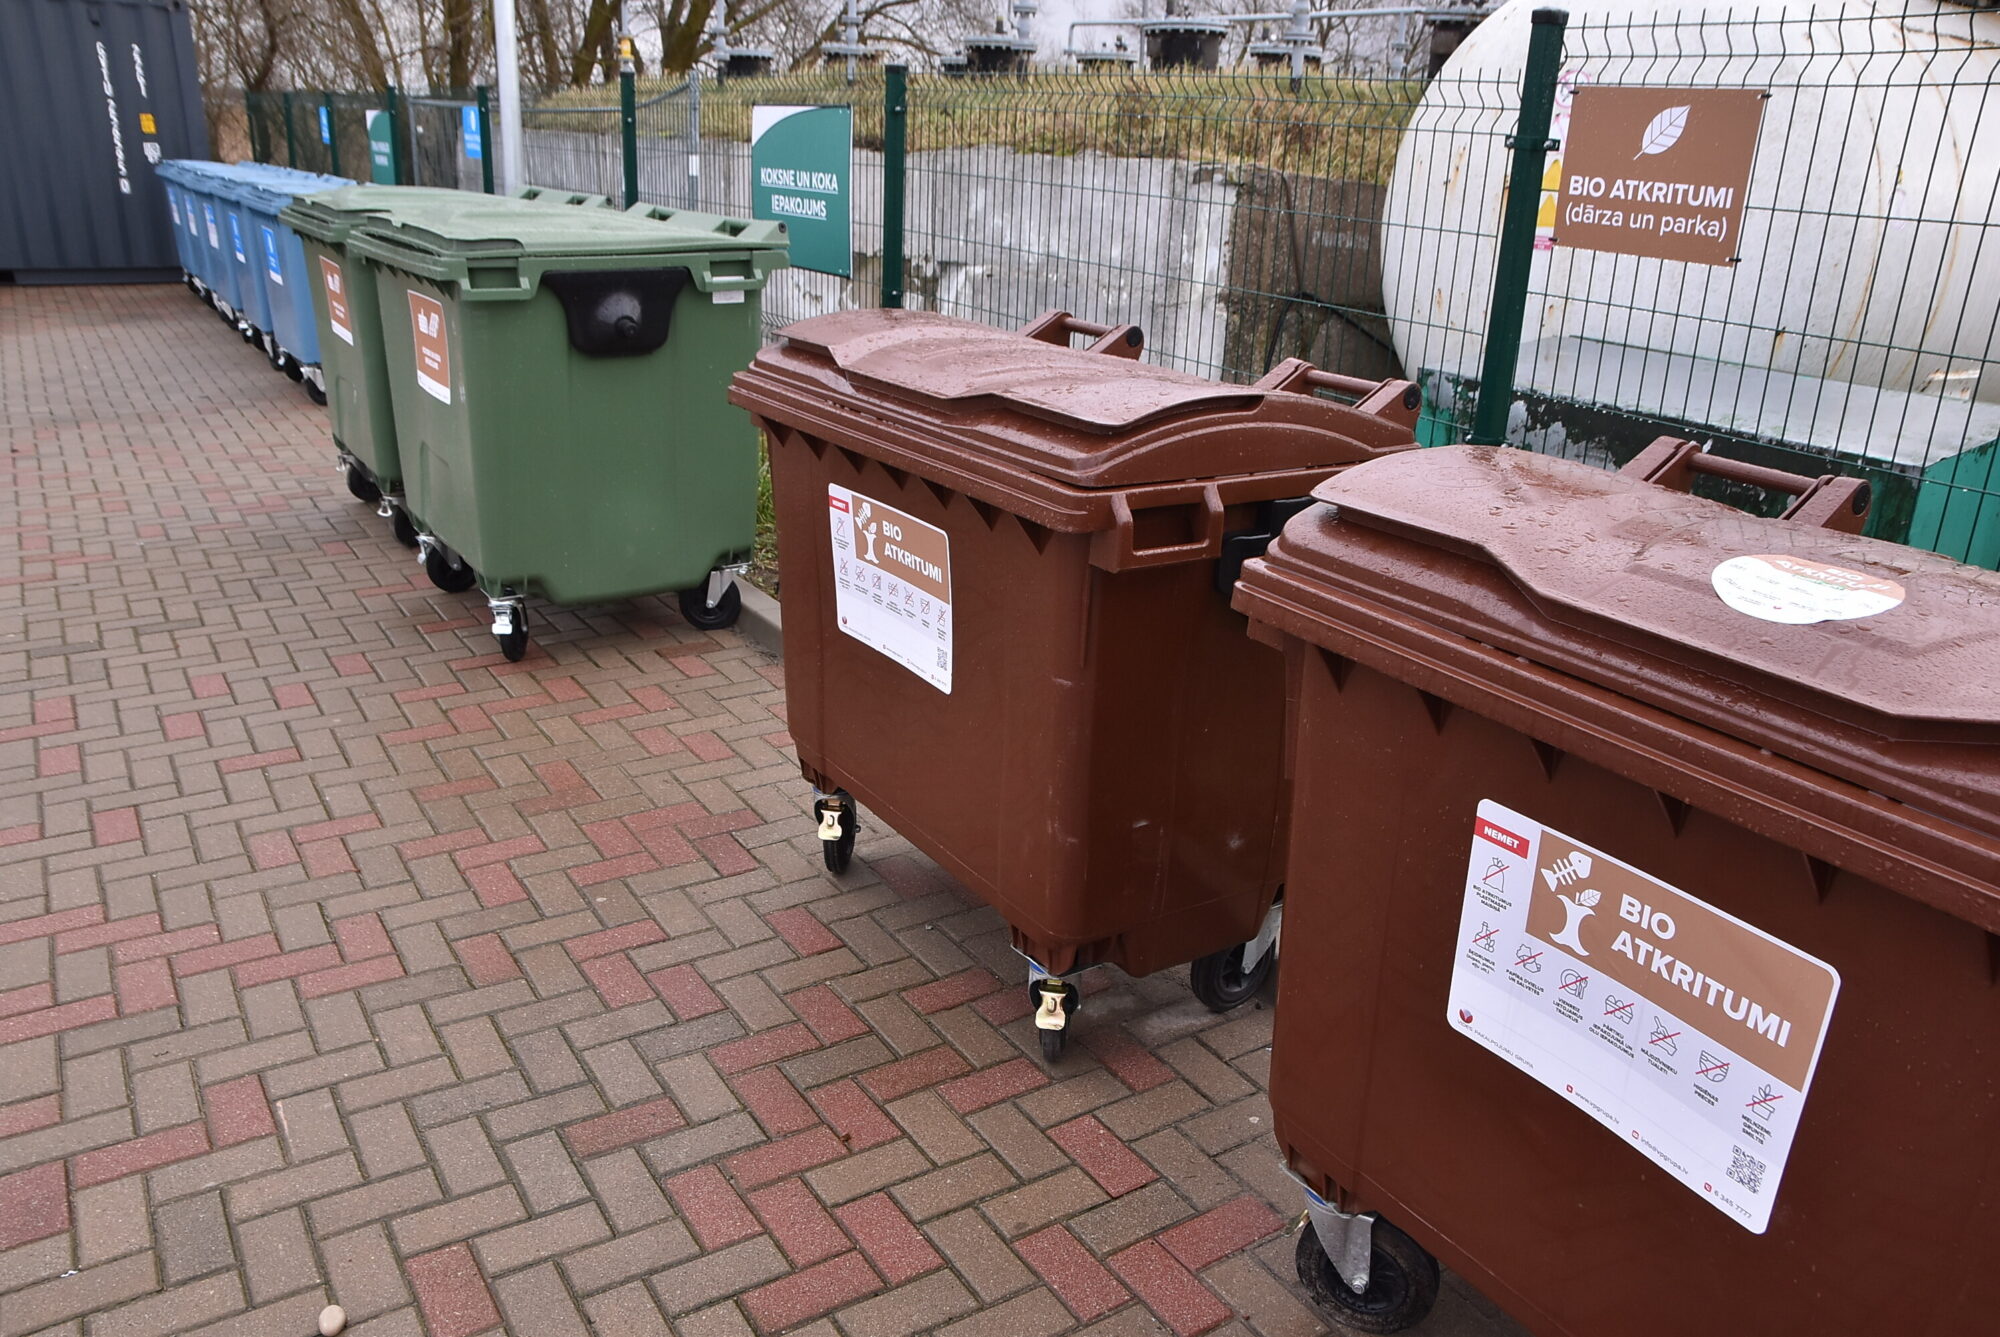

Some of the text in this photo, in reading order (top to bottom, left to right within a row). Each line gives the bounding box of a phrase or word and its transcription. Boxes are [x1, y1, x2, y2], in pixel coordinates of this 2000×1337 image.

[760, 167, 838, 192] KOKSNE UN KOKA
[1568, 175, 1734, 209] BIO ATKRITUMI
[772, 194, 826, 218] IEPAKOJUMS
[1565, 202, 1728, 242] (dārza un parka)
[882, 520, 902, 542] BIO
[884, 542, 942, 584] ATKRITUMI
[1822, 568, 1863, 581] BIO
[1484, 826, 1520, 848] NEMET
[1476, 892, 1506, 910] PLASTMASAS
[1619, 893, 1676, 940] BIO
[1509, 975, 1516, 983] UN
[1610, 930, 1791, 1048] ATKRITUMI
[1553, 1000, 1583, 1020] LIETOJAMUS
[1556, 1007, 1579, 1024] TRAUKUS
[1558, 997, 1580, 1013] VIENREIZ
[1589, 1026, 1634, 1058] OLU IEPAKOJUMUS
[1625, 1043, 1633, 1051] UN
[1514, 1054, 1534, 1069] GRUPA
[1575, 1092, 1619, 1124] www.vpgrupa.lv
[1694, 1090, 1714, 1106] PRECES
[1742, 1128, 1764, 1145] SMILTIS
[1641, 1137, 1688, 1174] info@vpgrupa.lv
[1720, 1194, 1734, 1207] 345
[1735, 1204, 1752, 1218] 7777
